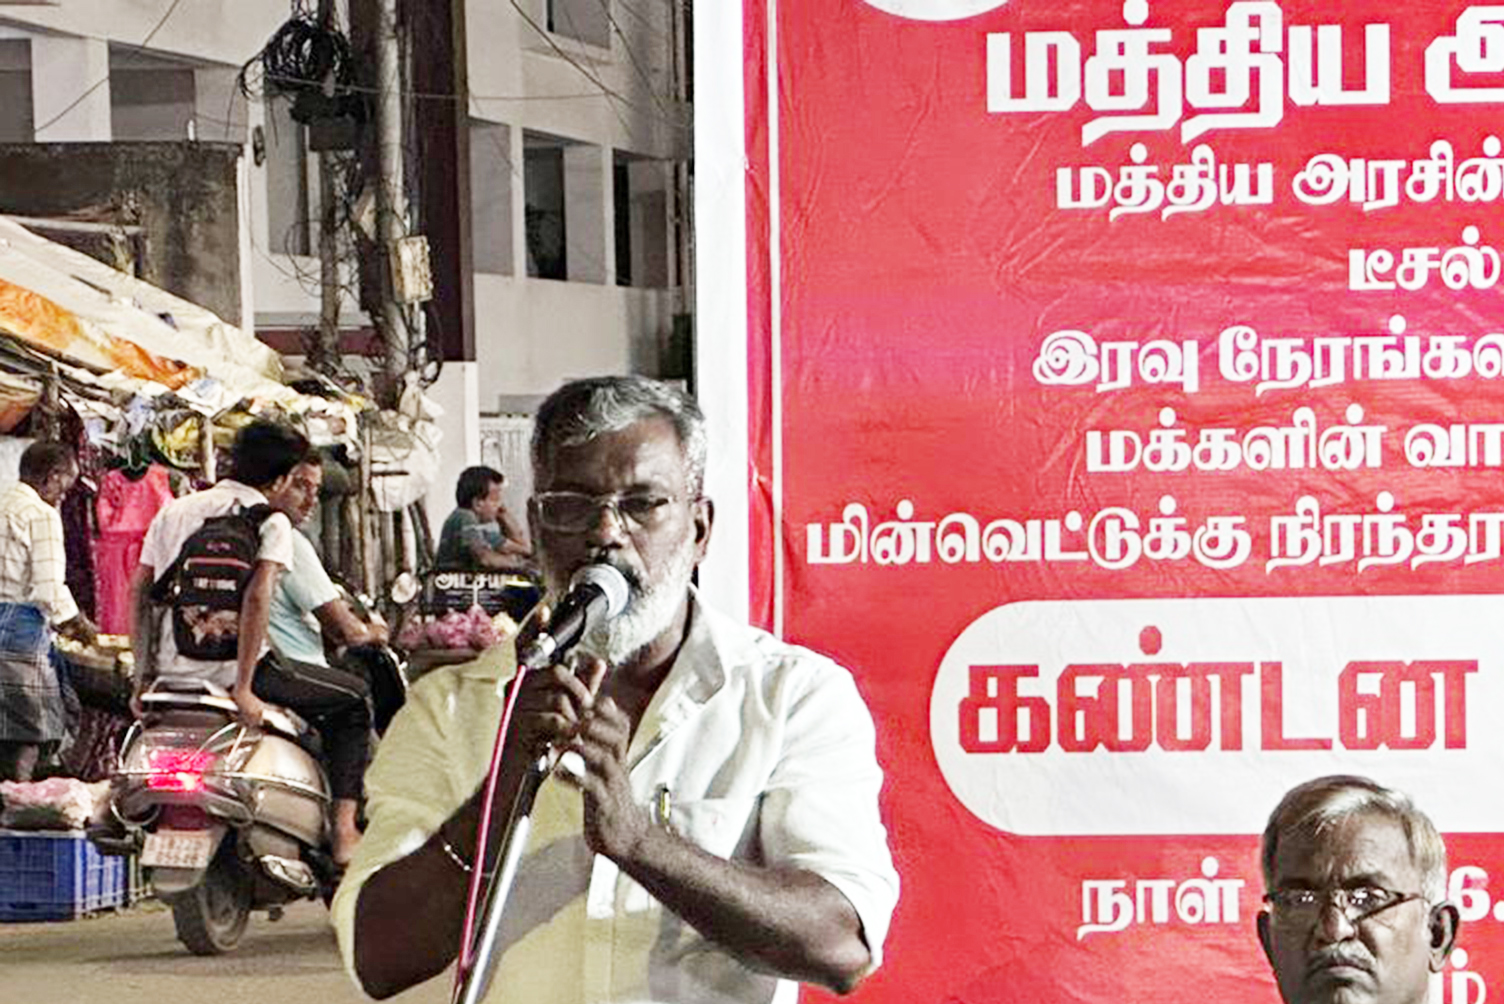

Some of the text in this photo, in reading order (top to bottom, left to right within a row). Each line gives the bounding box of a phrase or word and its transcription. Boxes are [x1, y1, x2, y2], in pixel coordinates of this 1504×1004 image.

[986, 0, 1390, 146] மத்திய
[1057, 143, 1273, 222] மத்திய
[1349, 226, 1500, 290] டீசல்
[1033, 330, 1199, 393] இரவு
[1087, 404, 1387, 472] மக்களின்
[807, 495, 1251, 570] மின்வெட்டுக்கு
[957, 626, 1478, 754] கண்டன
[1077, 856, 1245, 940] நாள்
